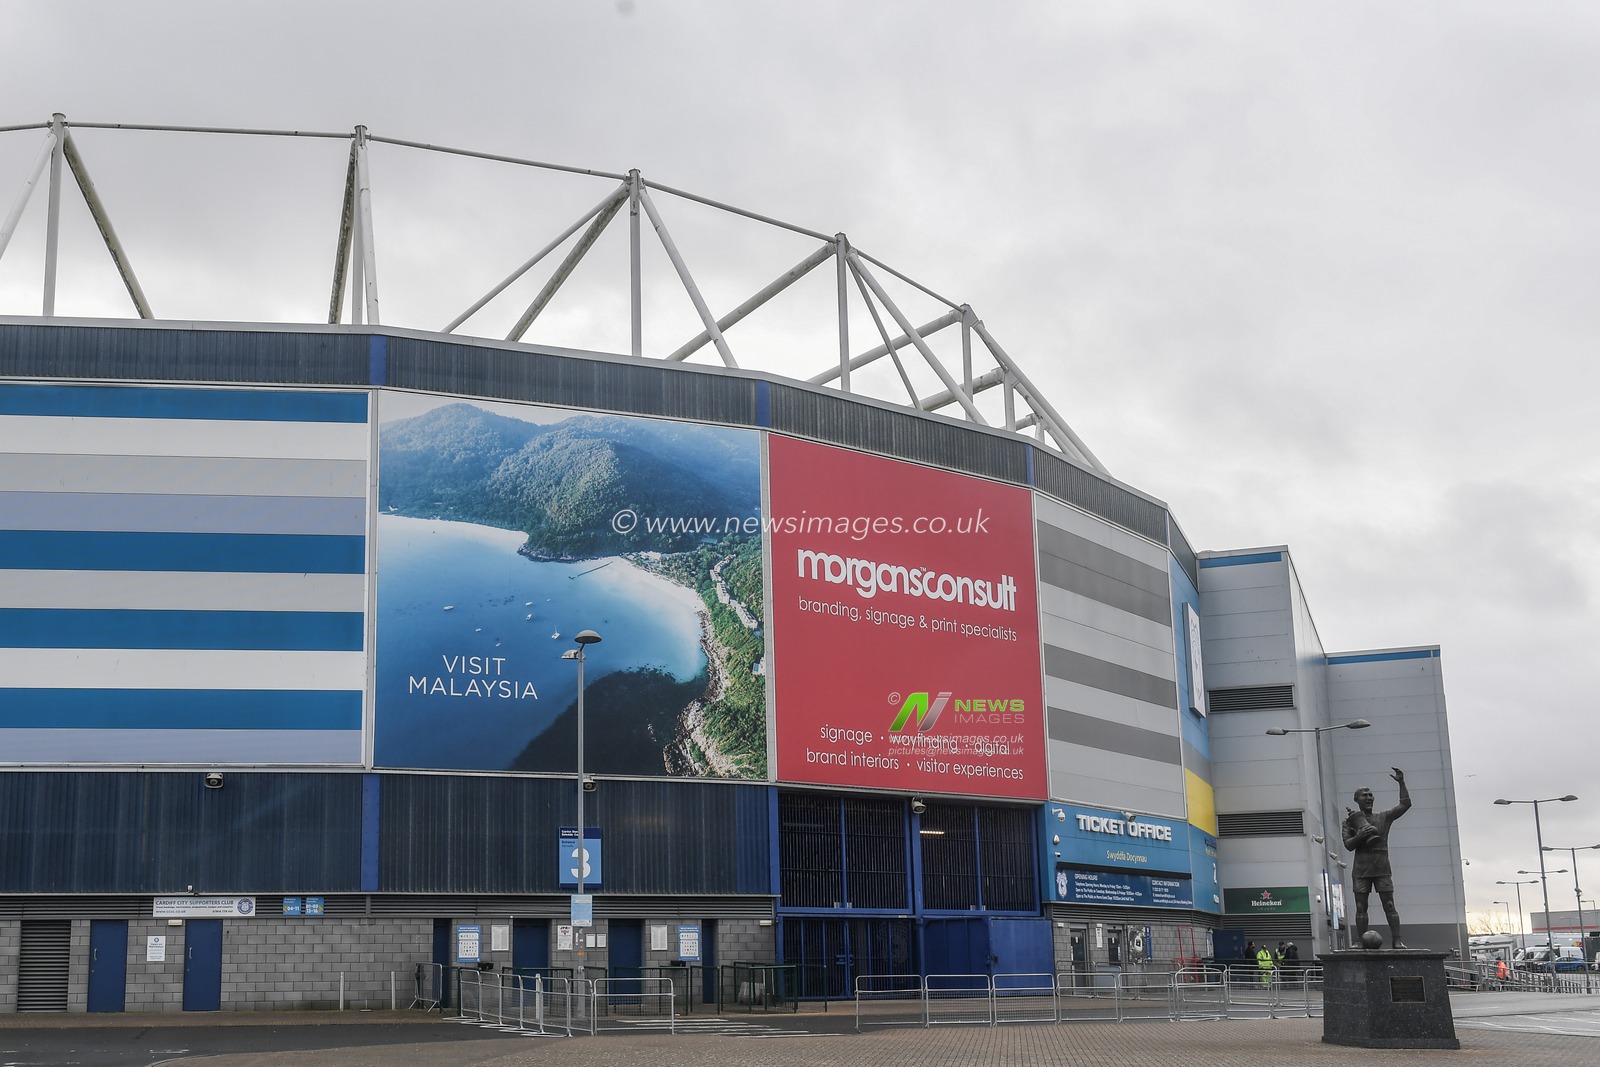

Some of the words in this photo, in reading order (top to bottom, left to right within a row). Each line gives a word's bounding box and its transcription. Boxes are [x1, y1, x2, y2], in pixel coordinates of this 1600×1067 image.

[798, 596, 862, 622] branding,
[865, 606, 915, 629] signage
[919, 614, 928, 629] &
[931, 617, 958, 634] print
[960, 622, 1017, 642] specialists
[442, 654, 506, 676] VISIT
[410, 676, 538, 700] MALAYSIA
[820, 724, 873, 746] signage
[889, 732, 958, 754] wayfinding
[974, 738, 1010, 757] digital
[806, 748, 846, 766] brand
[850, 751, 899, 770] interiors
[916, 758, 950, 774] visitor
[953, 762, 1024, 780] experiences
[1076, 814, 1126, 835] TICKET
[1127, 821, 1172, 842] OFFICE
[570, 848, 591, 878] 3
[1106, 850, 1126, 862] Swyddfa
